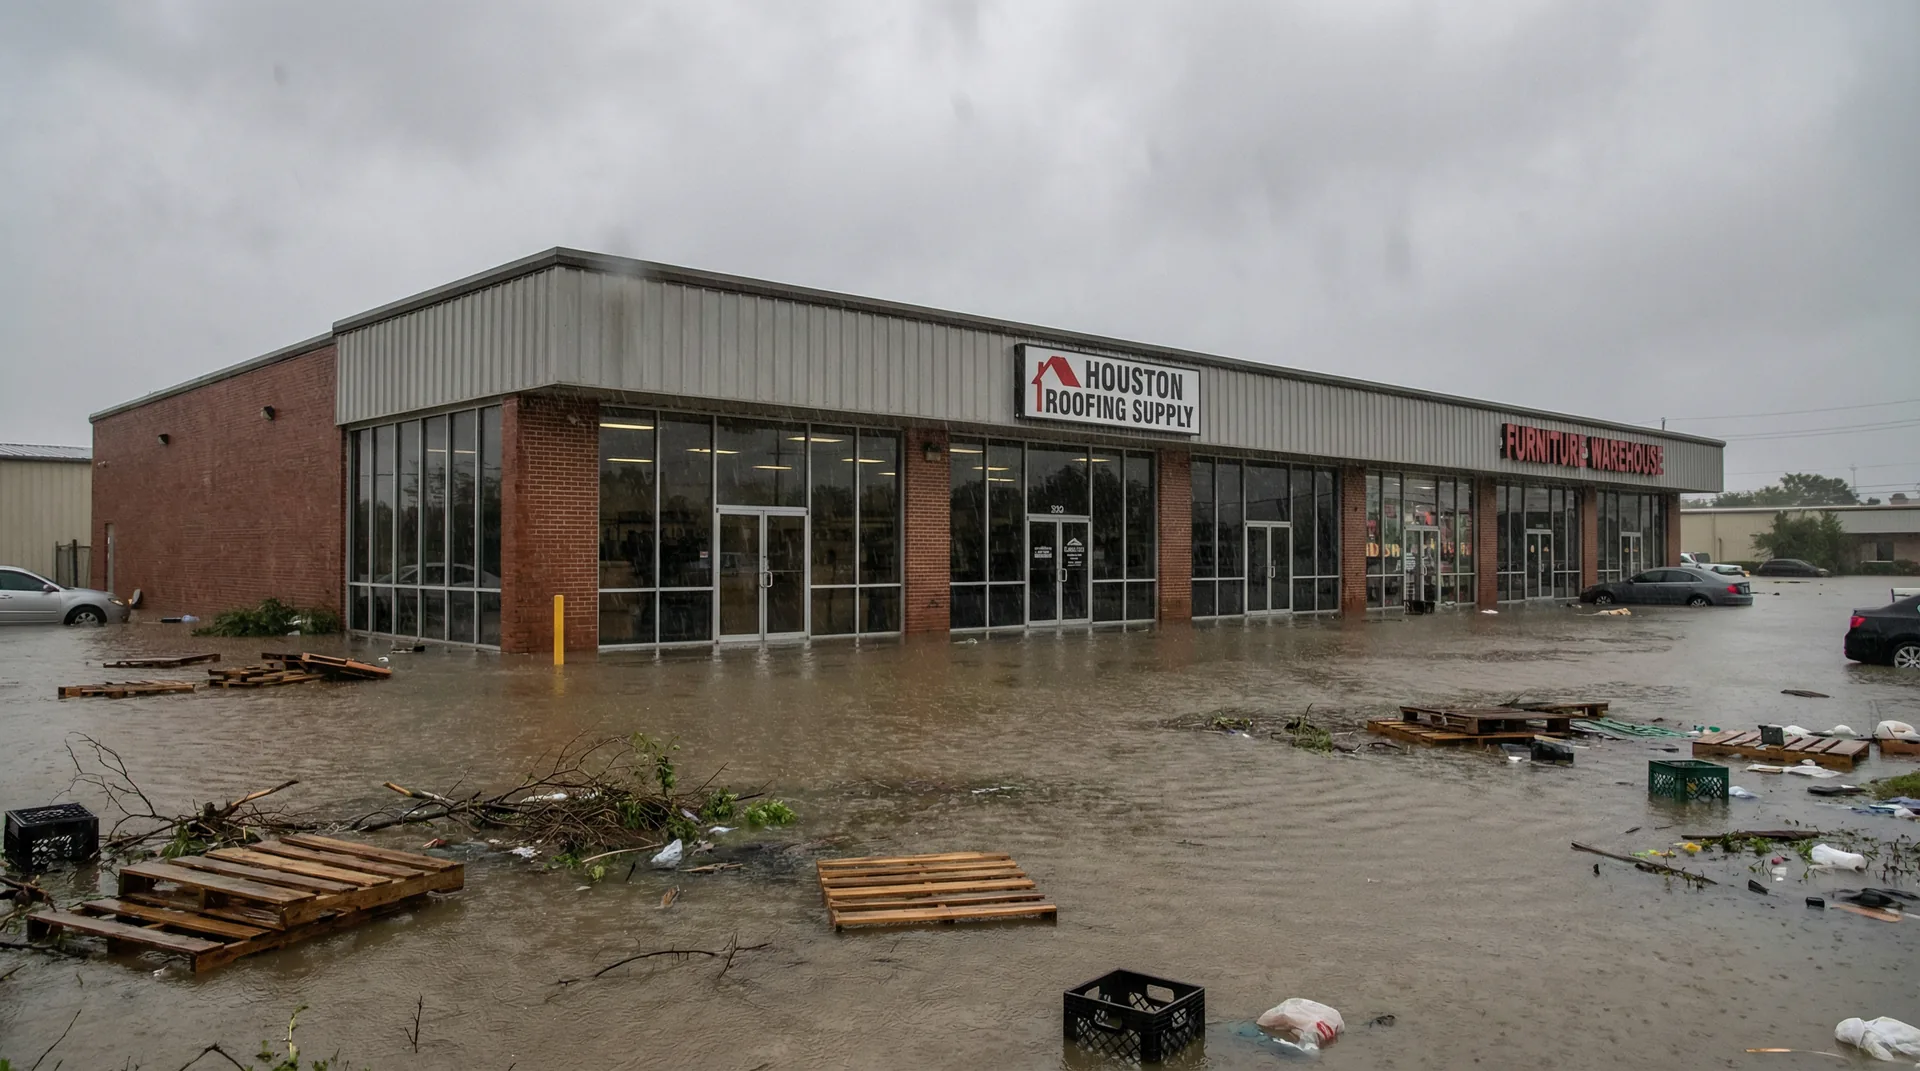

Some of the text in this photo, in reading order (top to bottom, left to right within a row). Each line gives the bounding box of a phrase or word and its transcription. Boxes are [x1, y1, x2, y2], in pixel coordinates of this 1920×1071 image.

[1085, 360, 1183, 400] HOUSTON
[1045, 388, 1194, 428] ROOFING SUPPLY
[1506, 424, 1664, 475] FURNITURE WAREHOUSE
